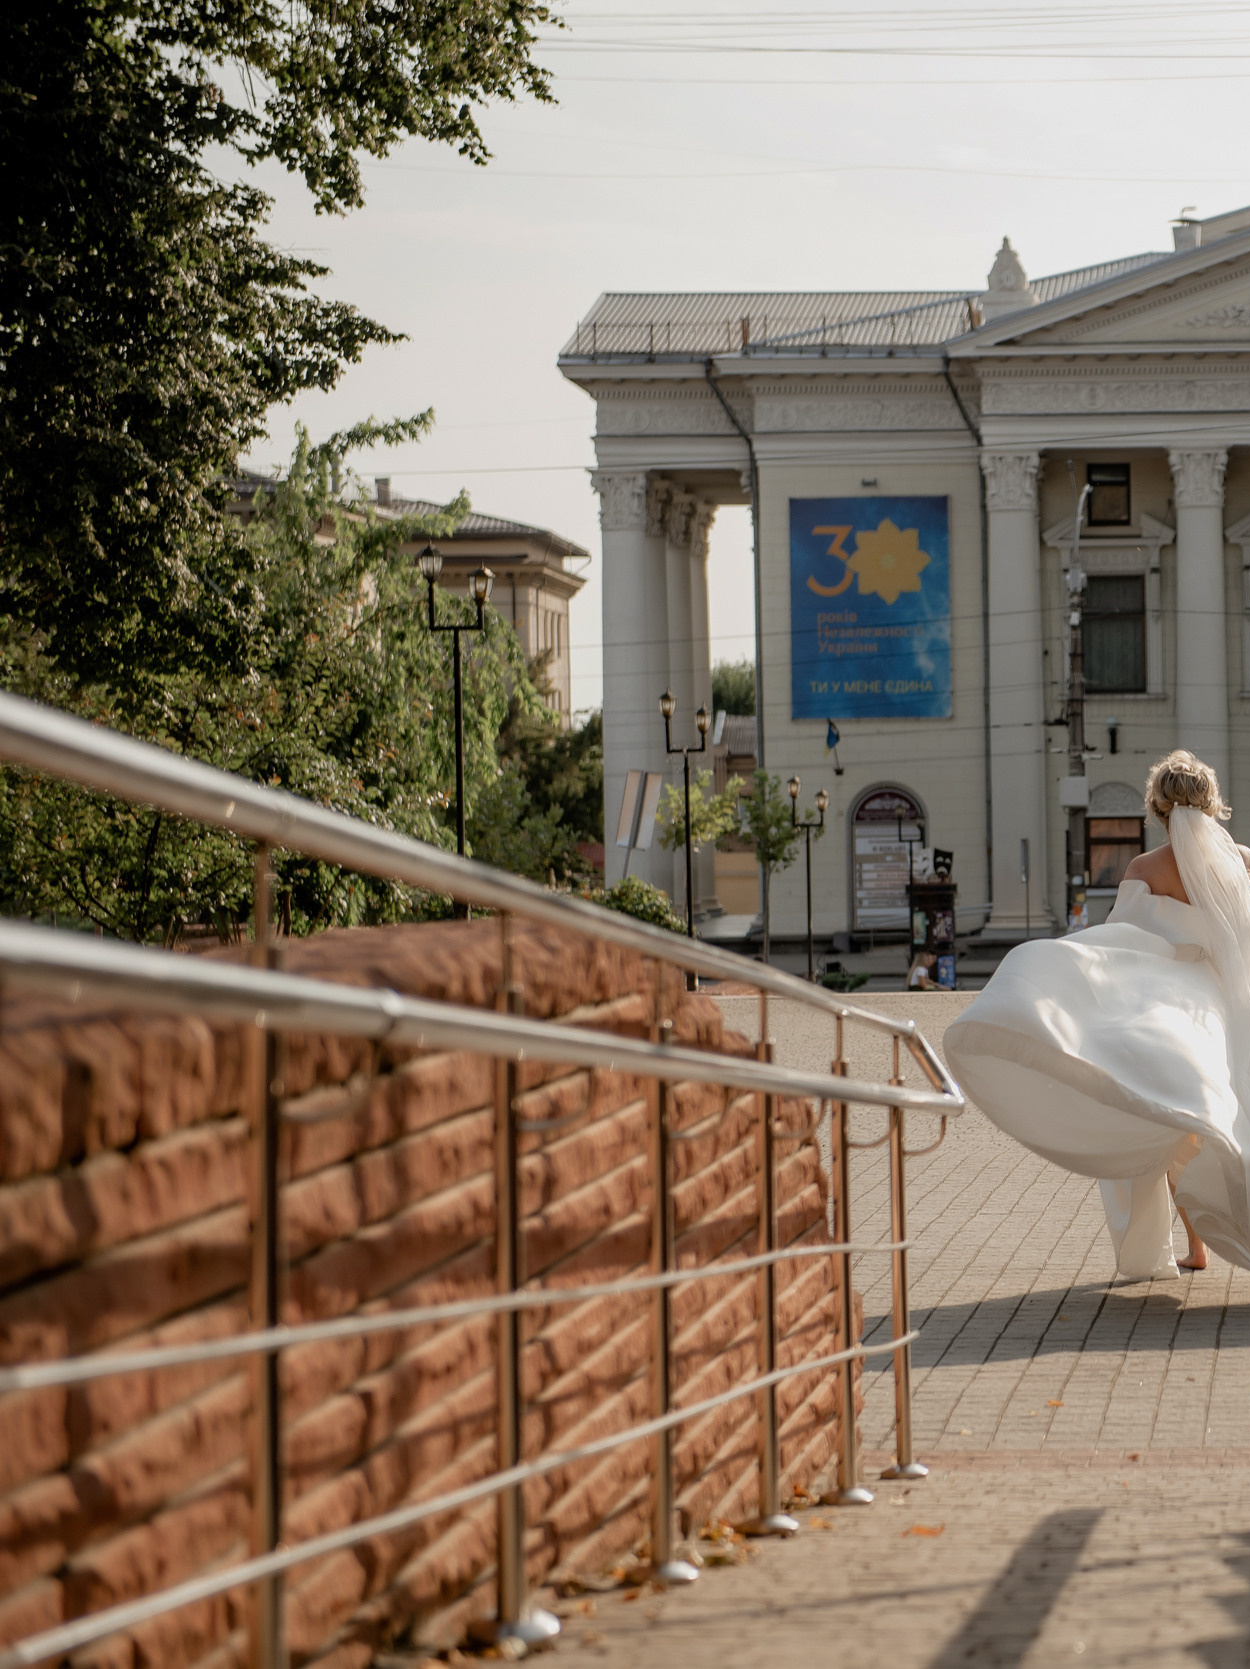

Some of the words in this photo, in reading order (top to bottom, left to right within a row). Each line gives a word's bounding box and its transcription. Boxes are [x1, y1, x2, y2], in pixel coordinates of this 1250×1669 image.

[817, 609, 857, 624] років
[817, 639, 879, 657] України
[810, 681, 828, 694] ТИ
[831, 681, 841, 694] У
[843, 680, 882, 694] МЕНЕ
[885, 679, 934, 695] ЄДИНА
